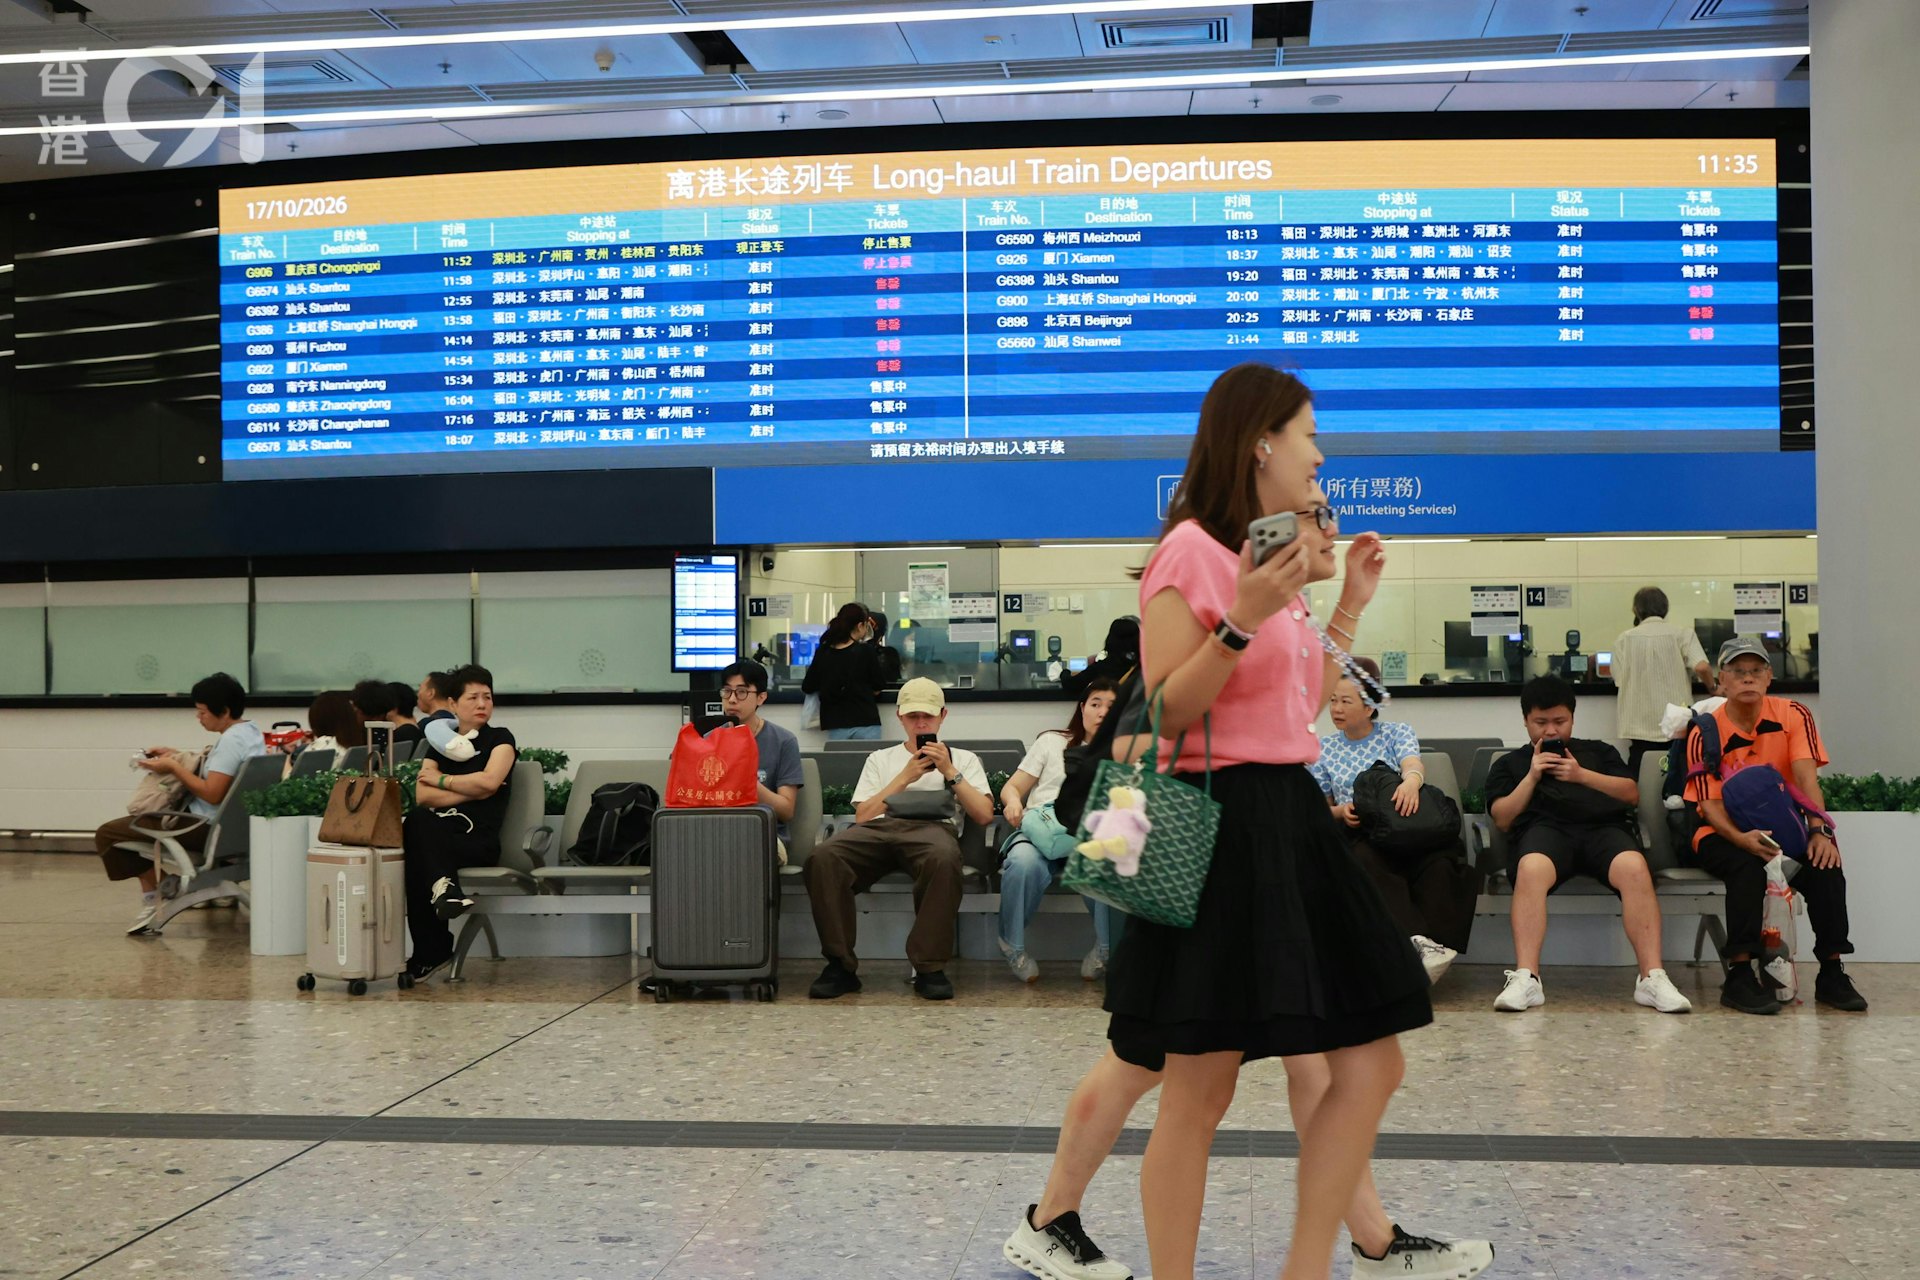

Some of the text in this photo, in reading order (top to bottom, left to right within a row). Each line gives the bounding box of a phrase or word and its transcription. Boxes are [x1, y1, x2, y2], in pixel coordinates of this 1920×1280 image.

[1698, 154, 1758, 174] 11:35
[667, 156, 1272, 200] 离港长途列车 Long-haul Train Departures
[246, 196, 347, 220] 17/10/2026
[991, 190, 1713, 212] 车次 目的地 时间 中途站 现况 车票
[242, 236, 264, 248] 车次
[333, 230, 367, 242] 目的地
[442, 223, 466, 236] 时间
[747, 208, 773, 220] 现况
[873, 204, 900, 216] 车票
[976, 204, 1721, 226] Train No. Destination Time Stopping at Status Tickets
[230, 218, 908, 260] Train No. Destination Time Stopping at Status Tickets
[996, 234, 1034, 245] G6590
[1043, 232, 1080, 244] 梅州西
[1084, 232, 1141, 243] Meizhouxi
[1226, 229, 1258, 240] 18:13
[1557, 224, 1583, 237] 准时
[1681, 223, 1718, 236] 售票中
[320, 263, 380, 274] Chongqingxi
[444, 256, 472, 266] 11:52
[996, 254, 1028, 265] G926
[1043, 252, 1068, 265] 厦门
[1071, 253, 1115, 263] Xiamen
[1227, 250, 1258, 260] 18:37
[1558, 244, 1583, 257] 准时
[1681, 244, 1718, 256] 售票中
[286, 283, 307, 295] 汕头
[309, 282, 350, 293] Shantou
[444, 275, 472, 286] 11:58
[748, 261, 772, 273] 准时
[996, 265, 1718, 286] G6398 汕头 Shantou 19:20 准时 售票中
[286, 303, 307, 315] 汕头
[309, 302, 350, 313] Shantou
[444, 296, 472, 306] 12:55
[748, 282, 773, 294] 准时
[996, 295, 1028, 306] G900
[1044, 292, 1094, 306] 上海虹桥
[1097, 293, 1150, 306] Shanghai
[1226, 291, 1259, 302] 20:00
[1558, 286, 1584, 299] 准时
[286, 320, 329, 334] 上海虹桥
[331, 320, 378, 332] Shanghai
[444, 315, 472, 325] 13:58
[749, 302, 773, 314] 准时
[997, 316, 1028, 327] G898
[1044, 314, 1081, 327] 北京西
[1084, 314, 1132, 328] Beijingxi
[1226, 312, 1259, 323] 20:25
[1558, 307, 1584, 320] 准时
[310, 342, 346, 352] Fuzhou
[444, 336, 473, 346] 14:14
[749, 322, 773, 335] 准时
[997, 337, 1036, 348] G5660
[1044, 335, 1069, 348] 汕尾
[1072, 336, 1121, 346] Shanwei
[1227, 334, 1259, 344] 21:44
[1559, 328, 1584, 341] 准时
[286, 361, 308, 374] 厦门
[310, 362, 348, 372] Xiamen
[445, 356, 473, 366] 14:54
[749, 343, 774, 356] 准时
[286, 380, 318, 393] 南宁东
[321, 379, 386, 391] Nanningdong
[444, 375, 473, 385] 15:34
[749, 363, 774, 376] 准时
[320, 399, 391, 411] Zhaoqingdong
[444, 395, 473, 406] 16:04
[750, 384, 774, 396] 准时
[870, 380, 907, 393] 售票中
[287, 419, 319, 432] 长沙南
[320, 418, 389, 431] Changshanan
[445, 414, 474, 425] 17:16
[750, 404, 774, 416] 准时
[870, 400, 906, 413] 售票中
[287, 440, 308, 452] 汕头
[310, 440, 352, 450] Shantou
[445, 435, 474, 445] 18:07
[750, 424, 774, 437] 准时
[870, 421, 907, 434] 售票中
[870, 440, 1064, 458] 请预留充裕时间办理出入境手续
[1337, 504, 1456, 517] All Ticketing Services)
[1005, 598, 1020, 610] 12
[1528, 591, 1544, 602] 14
[1791, 588, 1806, 600] 15
[751, 601, 764, 614] 11
